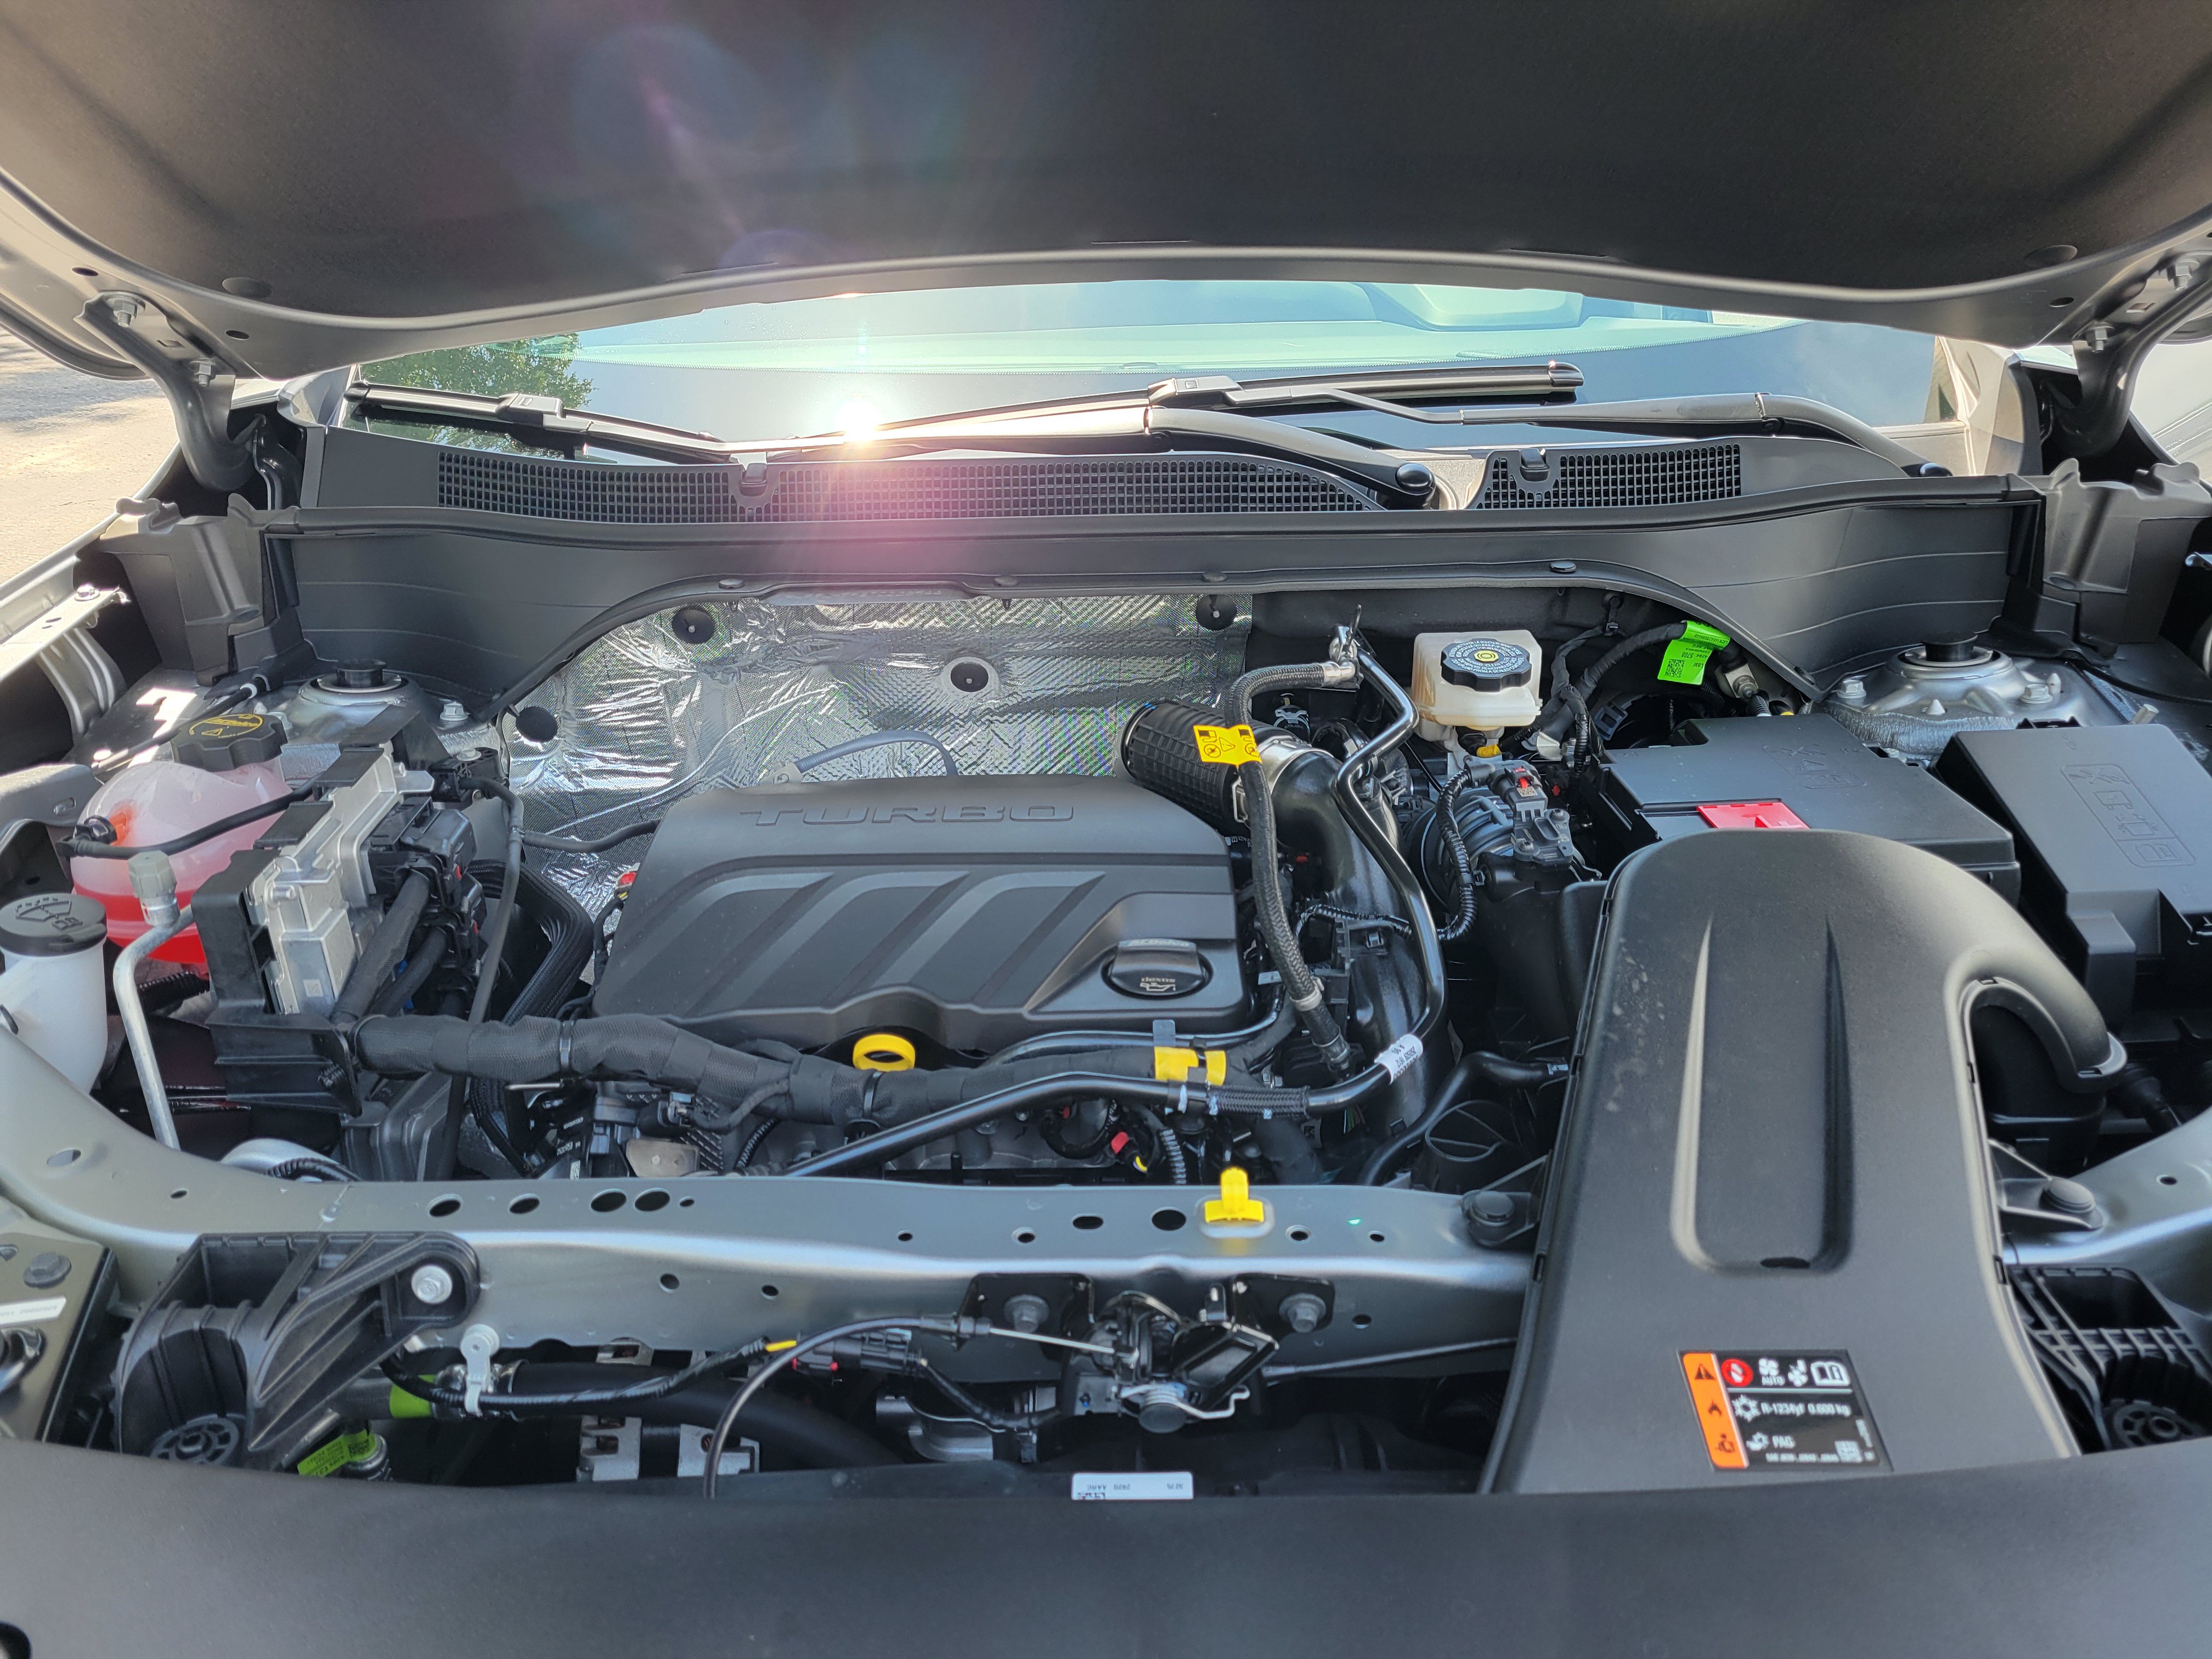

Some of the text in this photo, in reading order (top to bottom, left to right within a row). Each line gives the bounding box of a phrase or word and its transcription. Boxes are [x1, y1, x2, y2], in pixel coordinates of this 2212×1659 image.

[740, 805, 1074, 826] TURBO
[1761, 1375, 1786, 1386] AUTO
[1760, 1402, 1805, 1417] R-1234yf
[1835, 1403, 1852, 1418] kg
[1772, 1435, 1796, 1449] PAG
